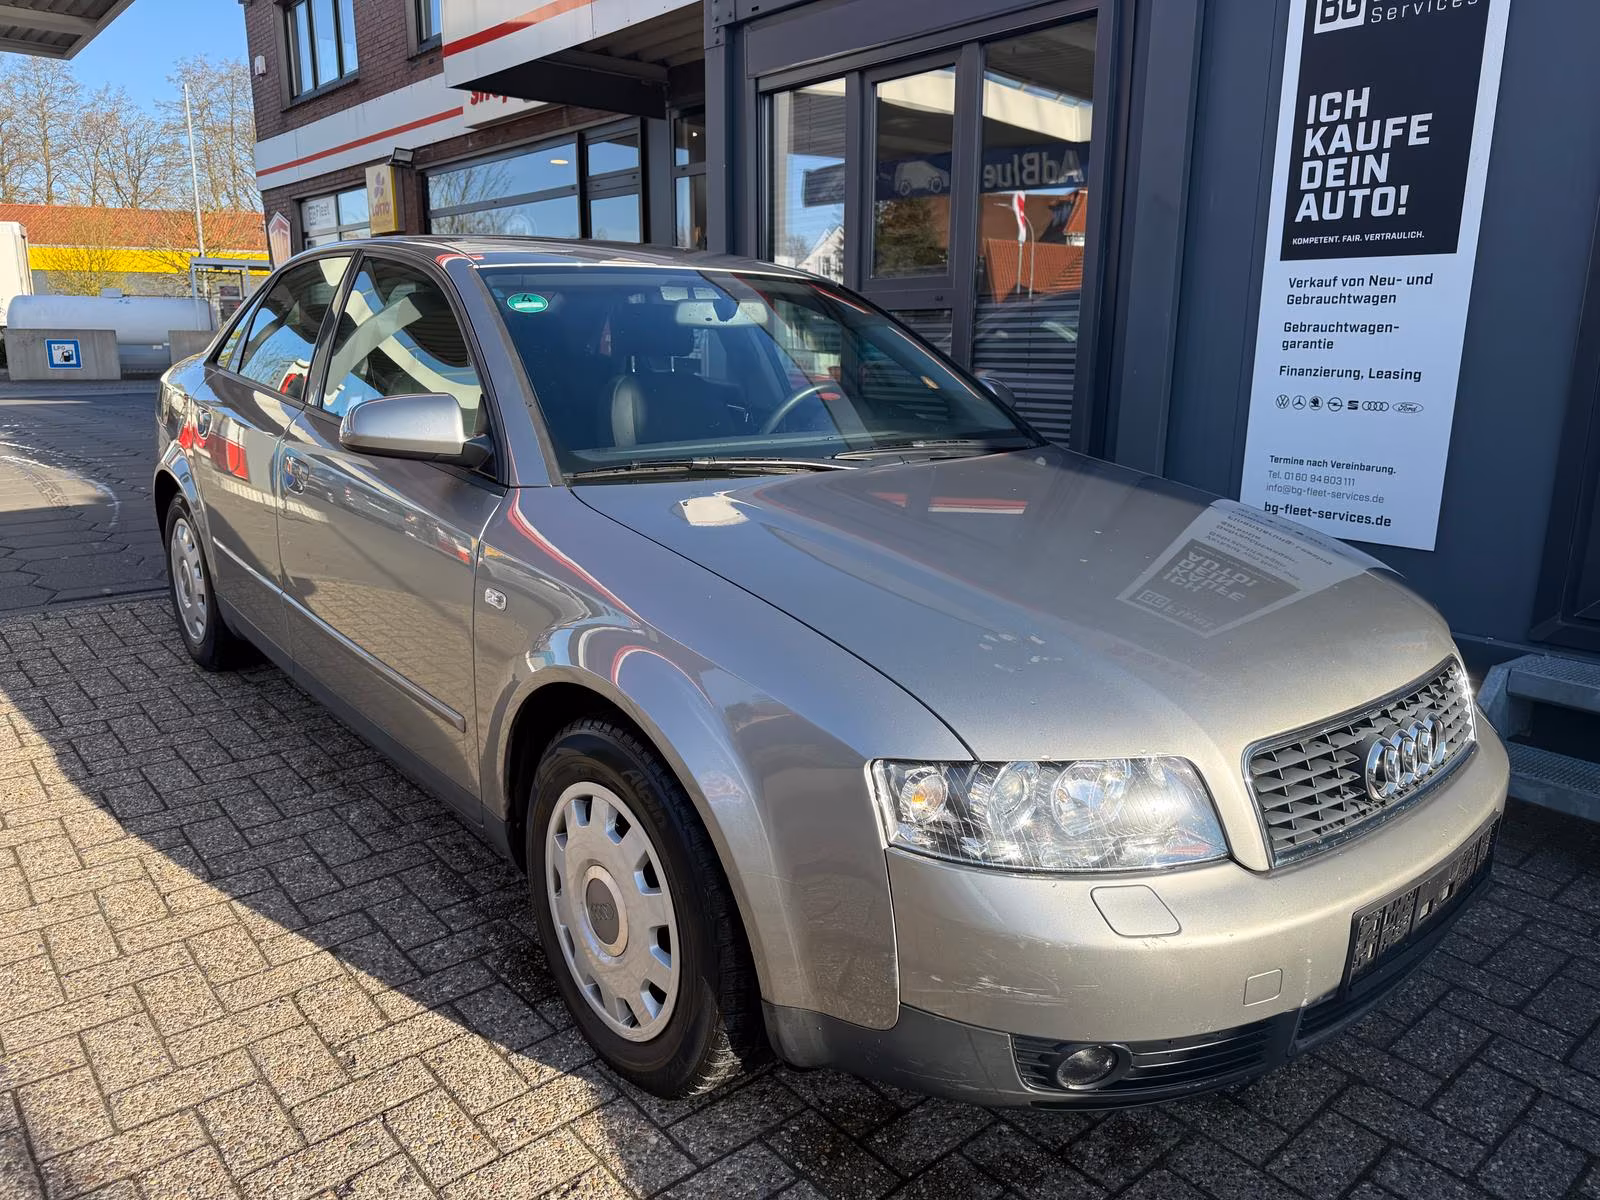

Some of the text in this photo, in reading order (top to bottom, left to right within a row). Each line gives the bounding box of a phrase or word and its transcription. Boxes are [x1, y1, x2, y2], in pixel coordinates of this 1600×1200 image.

[1306, 87, 1371, 125] ICH
[1303, 112, 1433, 158] KAUFE
[1300, 152, 1390, 191] DEIN
[1294, 184, 1410, 223] AUTO!
[1292, 230, 1425, 246] KOMPETENT. FAIR. VERTRAULICH.
[1288, 273, 1434, 288] Verkauf von Neu- und
[1286, 293, 1397, 306] Gebrauchtwagen
[1283, 321, 1400, 335] Gebrauchtwagen-
[1281, 338, 1334, 351] garantie
[1279, 365, 1422, 383] Finanzierung, Leasing
[1396, 402, 1419, 413] Ford
[1269, 455, 1397, 475] Termine nach Vereinbarung.
[1268, 470, 1282, 480] Tel.
[1266, 483, 1385, 504] info@bg-fleet-services.de
[1263, 501, 1392, 527] bg-fleet-services.de
